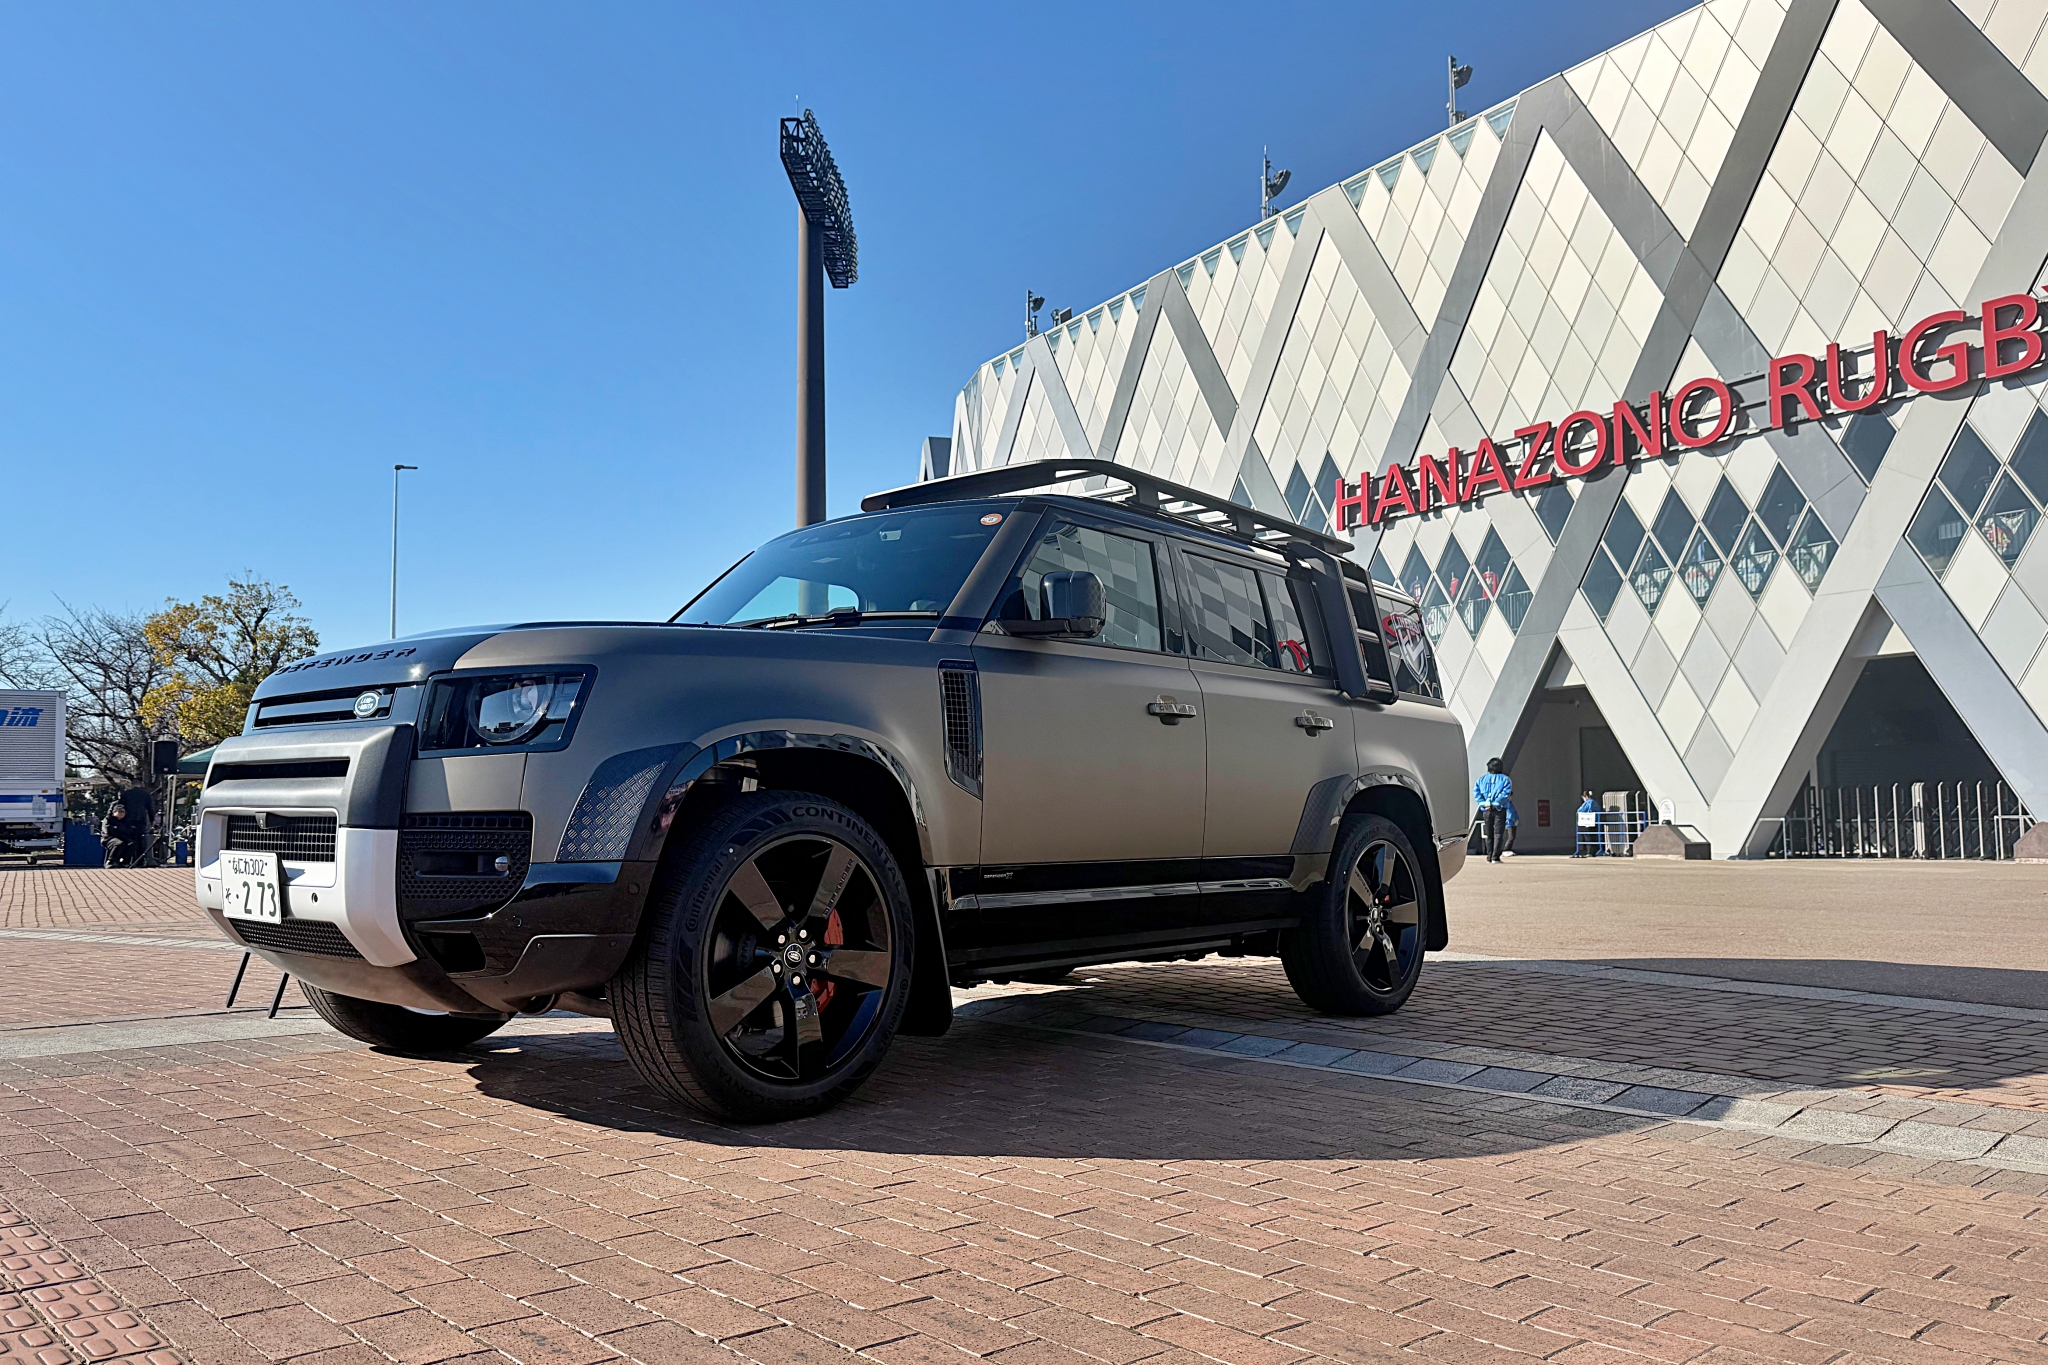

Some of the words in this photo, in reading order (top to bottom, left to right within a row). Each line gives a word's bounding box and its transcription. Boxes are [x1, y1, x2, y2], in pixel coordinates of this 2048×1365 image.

[1335, 377, 1731, 531] HANAZONO
[1769, 284, 2048, 428] RUGB
[275, 647, 417, 675] DEFENDER
[792, 806, 901, 893] CONTINENTAL
[685, 860, 723, 932] Continental
[822, 858, 854, 918] DEFENDER
